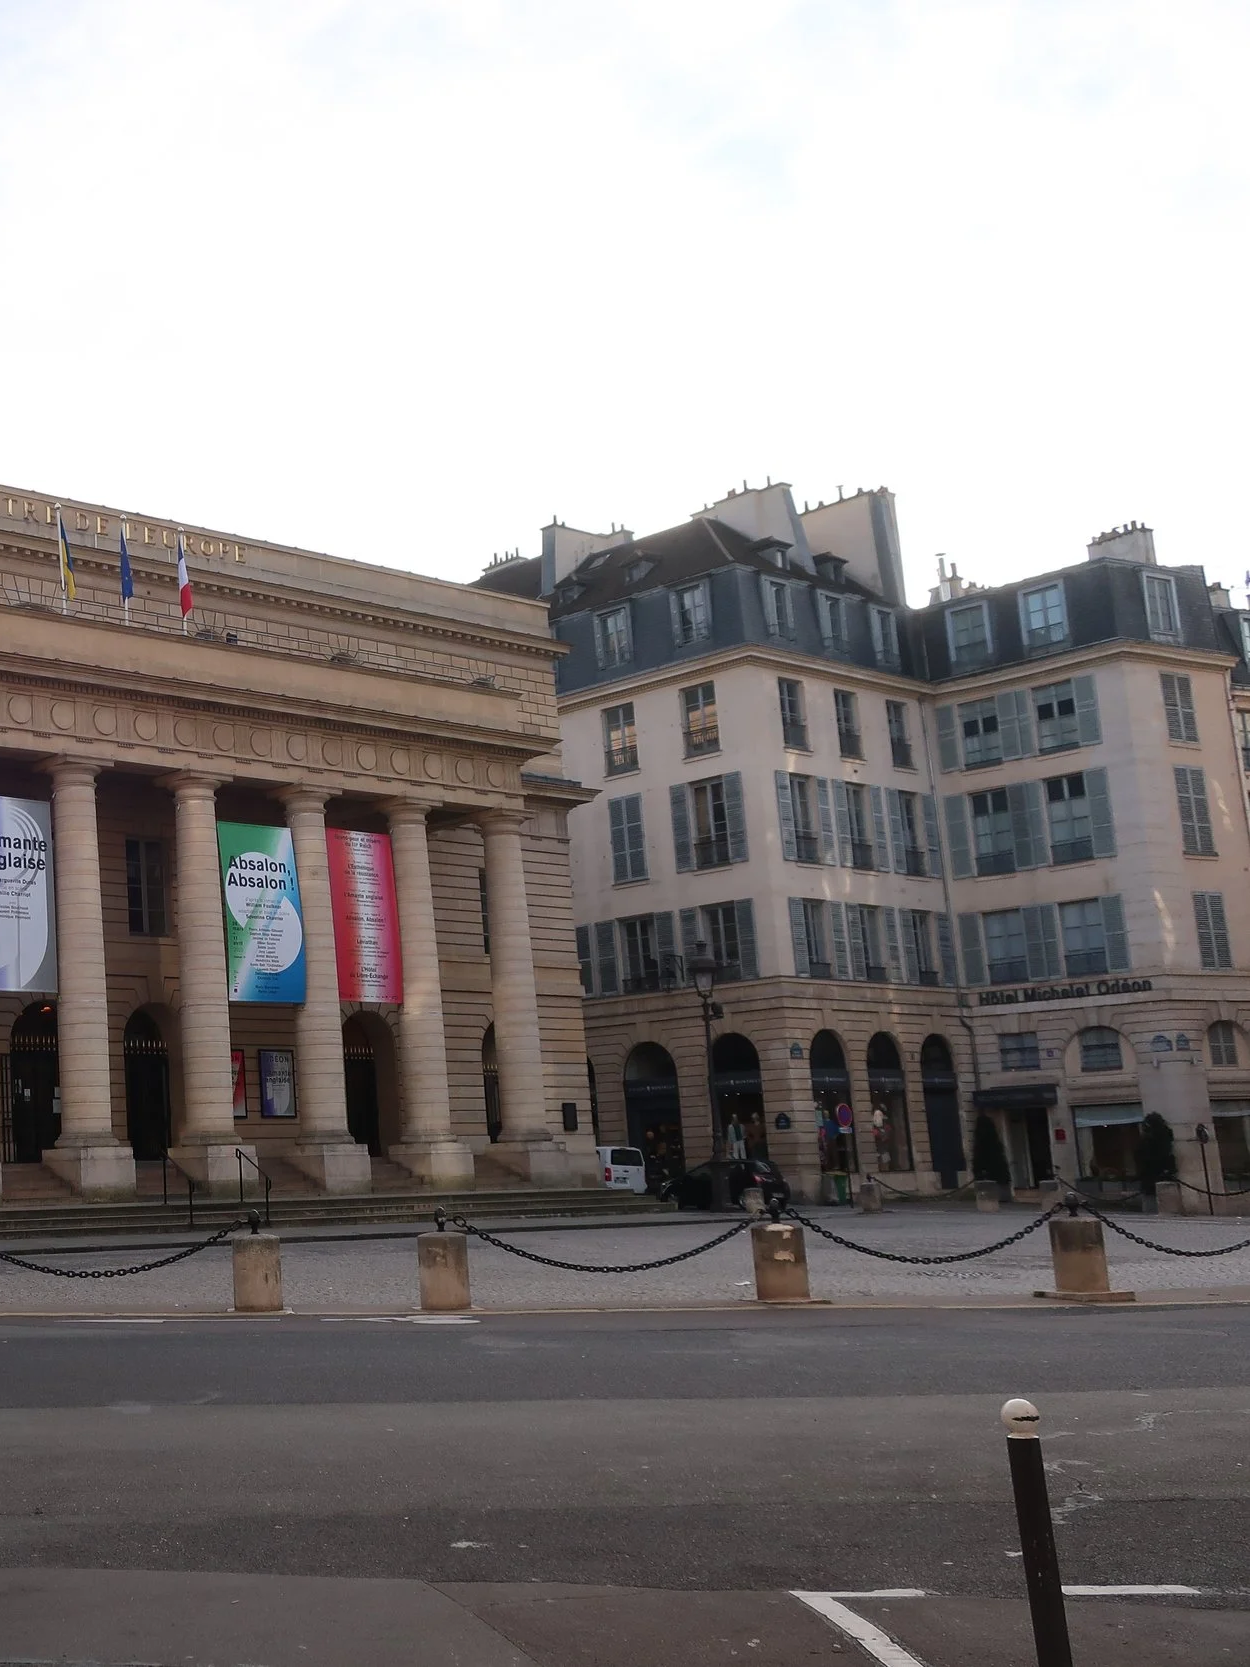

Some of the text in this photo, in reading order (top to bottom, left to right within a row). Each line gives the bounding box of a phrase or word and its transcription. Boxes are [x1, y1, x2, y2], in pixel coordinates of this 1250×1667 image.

[75, 512, 109, 536] DE
[125, 522, 248, 564] L'EUROPE
[229, 856, 290, 876] Absalon,
[228, 872, 286, 890] Absalon
[979, 979, 1153, 1006] Hôtel Michelet Odéon
